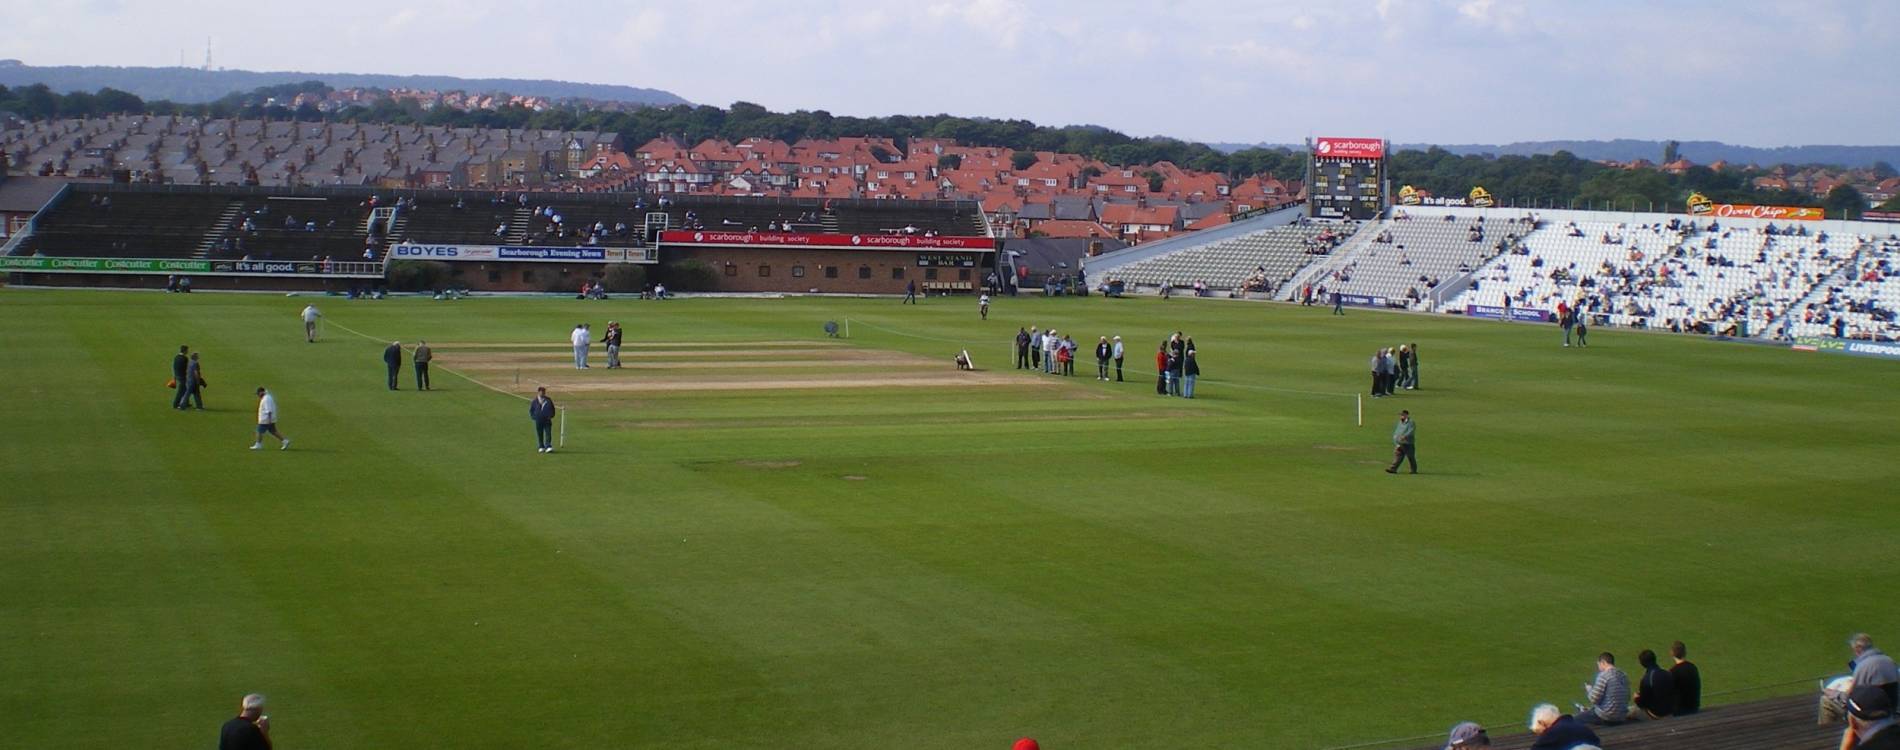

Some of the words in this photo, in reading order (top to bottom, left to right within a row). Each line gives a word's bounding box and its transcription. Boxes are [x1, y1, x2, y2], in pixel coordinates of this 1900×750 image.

[1333, 141, 1381, 152] scarborough
[1751, 205, 1788, 218] Chips
[709, 234, 754, 242] scarborough
[759, 235, 785, 243] building
[866, 236, 911, 246] scarborough
[916, 238, 941, 246] building
[943, 239, 966, 247] society
[397, 246, 458, 256] BOYES
[500, 249, 549, 258] Scarborough
[550, 250, 581, 258] Evening
[51, 258, 98, 268] Costcutter
[104, 259, 152, 269] Costcutter
[159, 261, 206, 270] Costcutter
[251, 262, 264, 271] all
[265, 262, 294, 272] good.
[1513, 309, 1541, 317] SCHOOL
